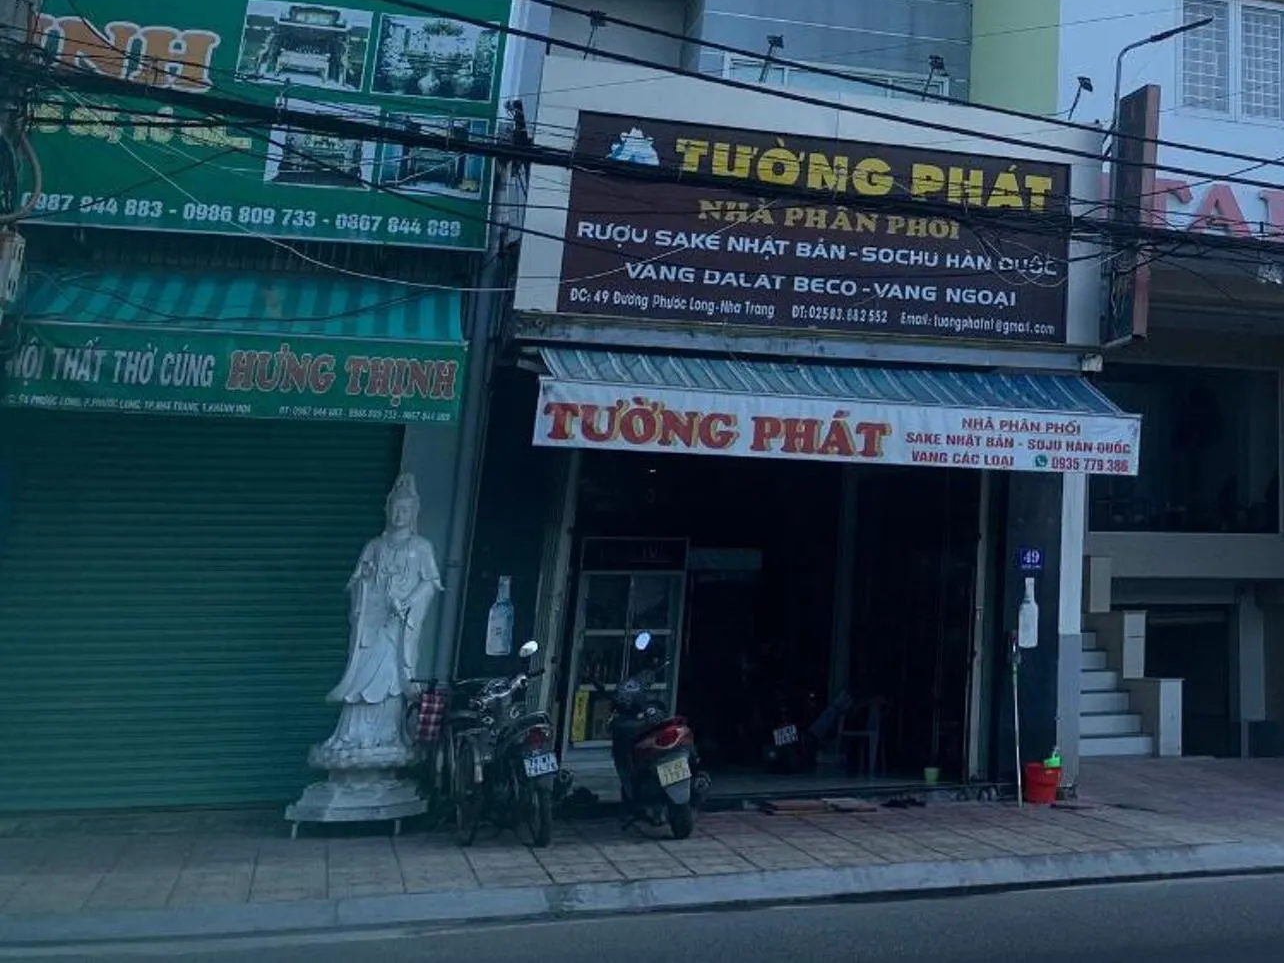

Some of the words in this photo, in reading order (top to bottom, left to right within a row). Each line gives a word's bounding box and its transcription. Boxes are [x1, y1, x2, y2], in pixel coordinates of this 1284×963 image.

[676, 137, 893, 196] TƯỜNG
[910, 164, 1053, 214] PHÁT
[183, 203, 231, 222] 0986
[238, 206, 275, 225] 809
[281, 209, 316, 227] 733
[698, 198, 774, 225] NHÀ
[784, 206, 877, 234] PHÂN
[576, 221, 648, 249] RƯỢU
[655, 231, 720, 251] SAKE
[726, 235, 791, 260] NHẬT
[946, 249, 992, 271] HÀN
[625, 262, 698, 284] VANG
[793, 276, 858, 297] BECO
[874, 282, 937, 303] VANG
[946, 289, 1017, 312] NGOẠI
[593, 291, 609, 304] 49
[745, 301, 776, 320] Trang
[52, 336, 107, 383] THẤT
[113, 342, 158, 384] THỜ
[160, 344, 216, 388] CÚNG
[345, 355, 459, 407] THỊNH
[543, 396, 740, 450] TƯỜNG
[750, 409, 894, 459] PHÁT
[905, 432, 942, 447] SAKE
[946, 433, 981, 450] NHẬT
[962, 416, 994, 432] NHÀ
[999, 417, 1041, 434] PHÂN
[1045, 419, 1083, 436] PHỐI
[911, 450, 948, 464] VANG
[951, 450, 980, 466] CÁC
[984, 453, 1015, 469] LOẠI
[1051, 455, 1079, 470] 0935
[1022, 550, 1040, 564] 49
